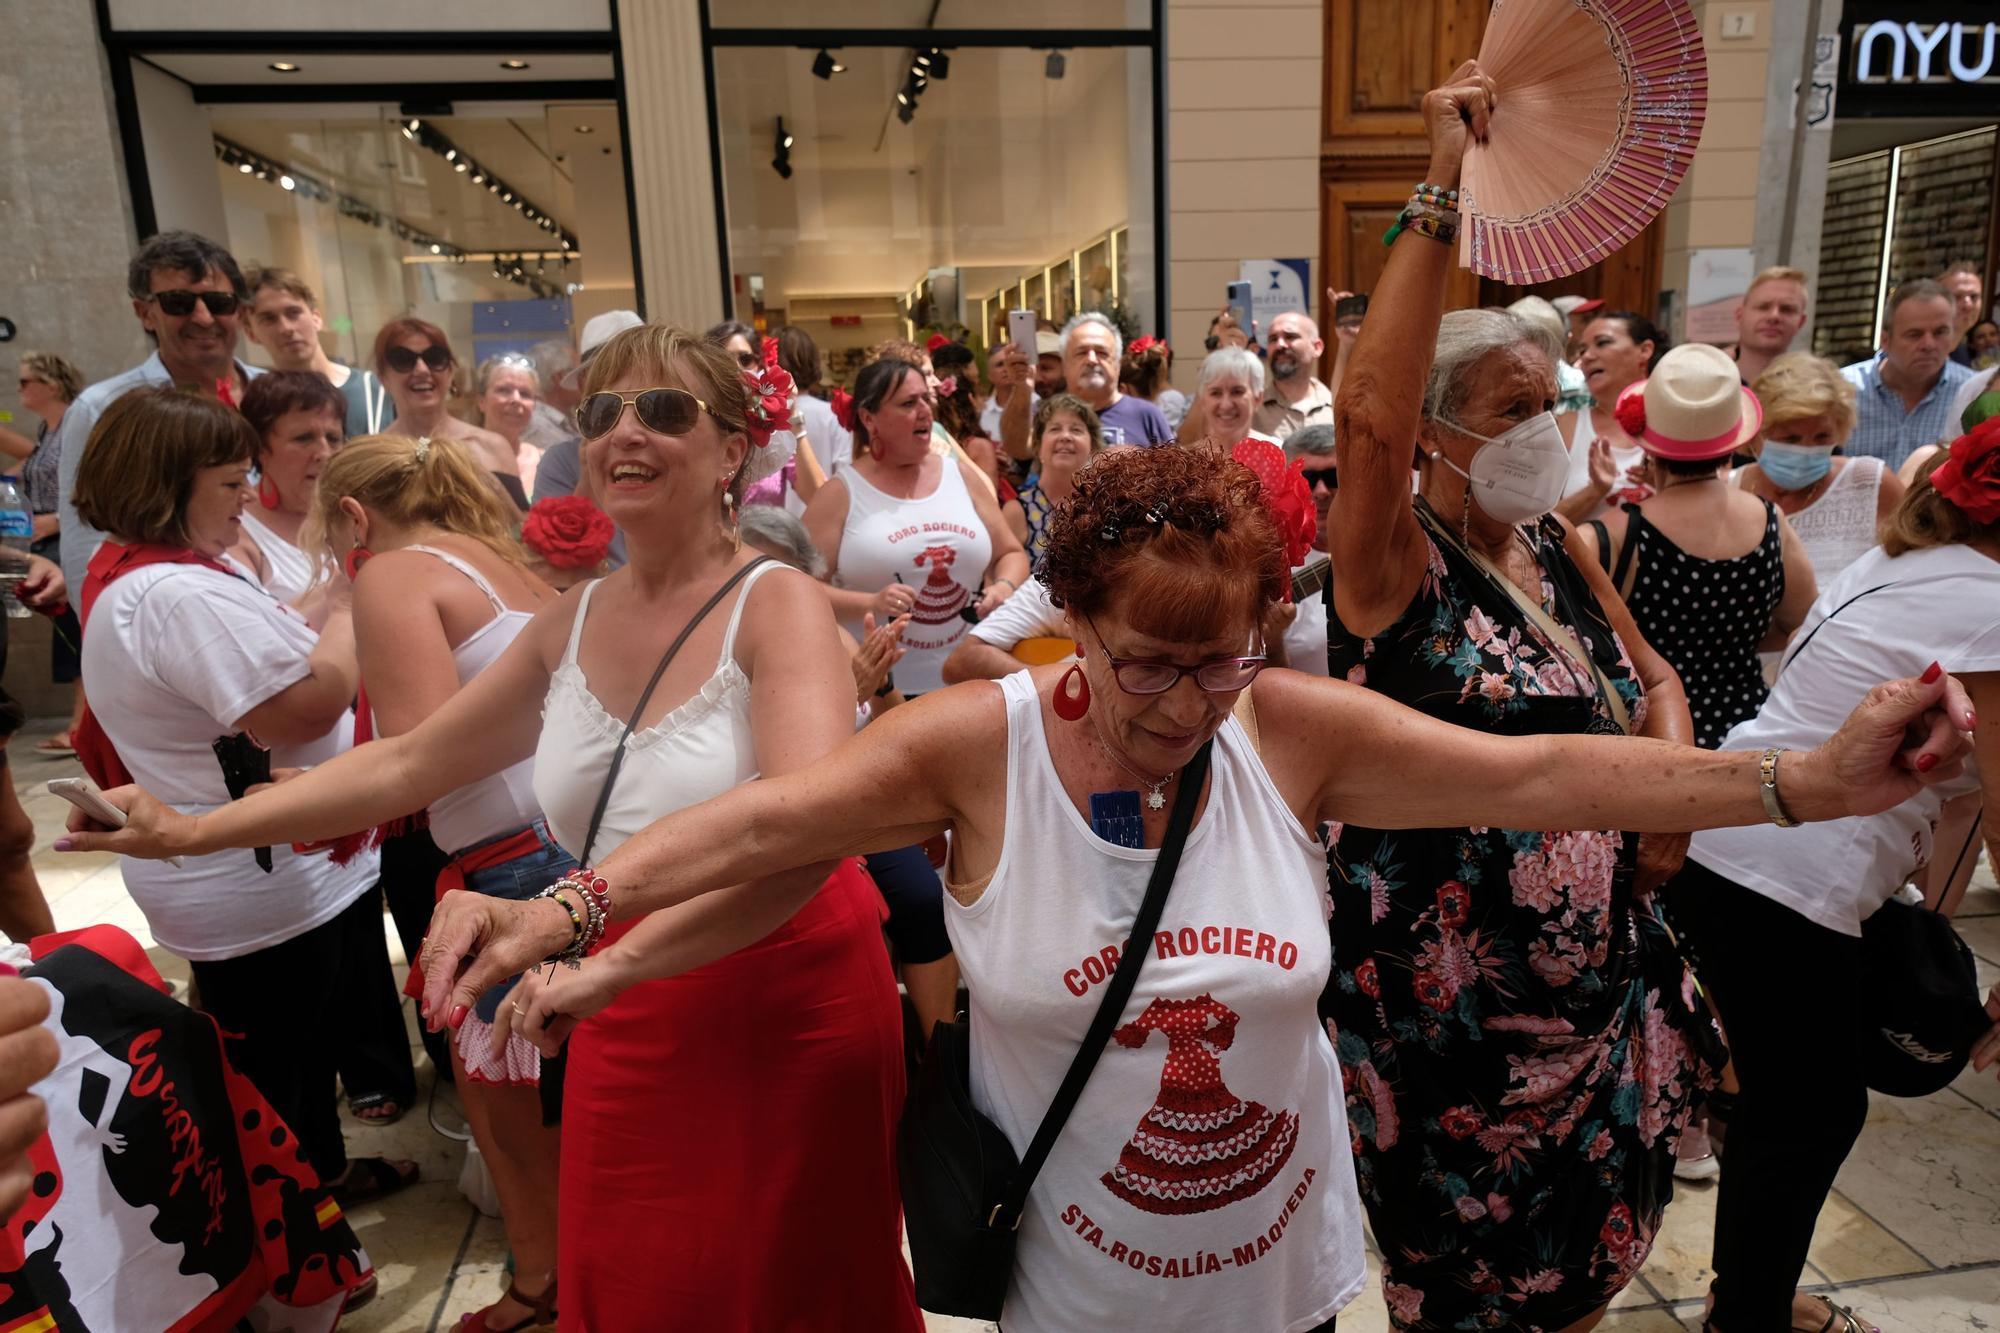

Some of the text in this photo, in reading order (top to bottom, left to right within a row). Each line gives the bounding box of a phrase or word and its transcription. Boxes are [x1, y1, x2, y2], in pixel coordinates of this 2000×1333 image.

[1735, 15, 1744, 33] 7
[888, 522, 977, 544] CORO ROCIERO
[1154, 926, 1298, 970] ROCIERO
[1060, 1167, 1317, 1279] STA.ROSALÍA-MAQUEDA
